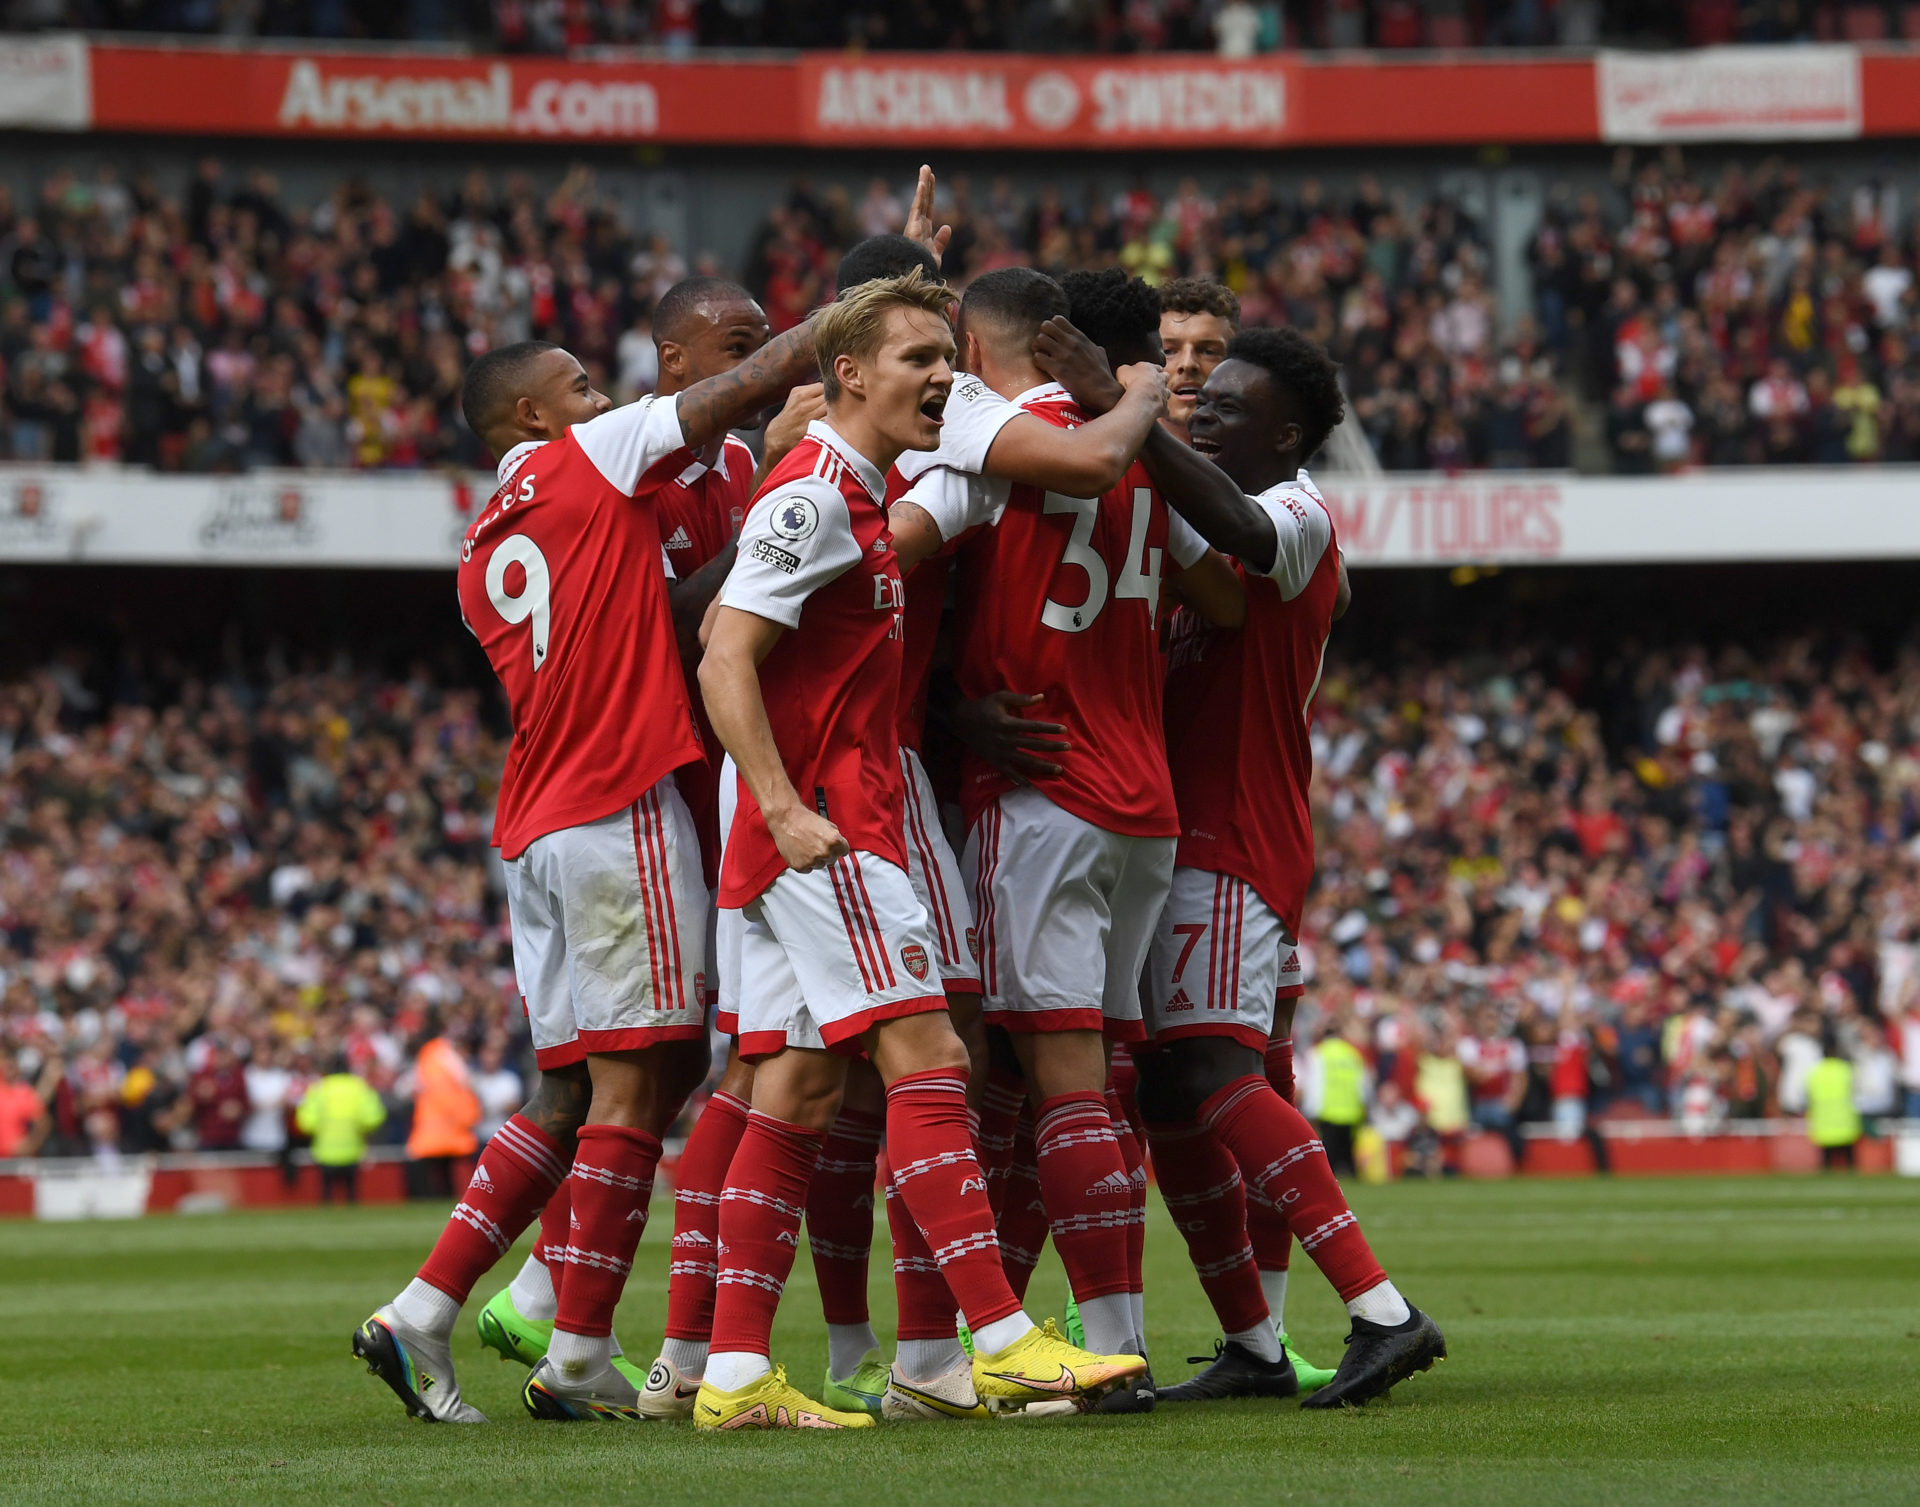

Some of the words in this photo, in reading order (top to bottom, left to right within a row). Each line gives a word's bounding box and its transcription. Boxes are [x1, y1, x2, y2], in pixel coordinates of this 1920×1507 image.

[280, 60, 658, 134] Arsenal.com
[817, 68, 1012, 132] ARSENAL
[1091, 69, 1287, 134] SWEDEN
[664, 540, 693, 550] adidas
[754, 540, 769, 553] No
[768, 546, 796, 566] room
[763, 553, 797, 576] racism
[1040, 487, 1163, 632] 34
[484, 532, 551, 674] 9
[1172, 923, 1209, 984] 7
[1165, 1001, 1195, 1013] adidas
[1086, 1184, 1131, 1196] adida
